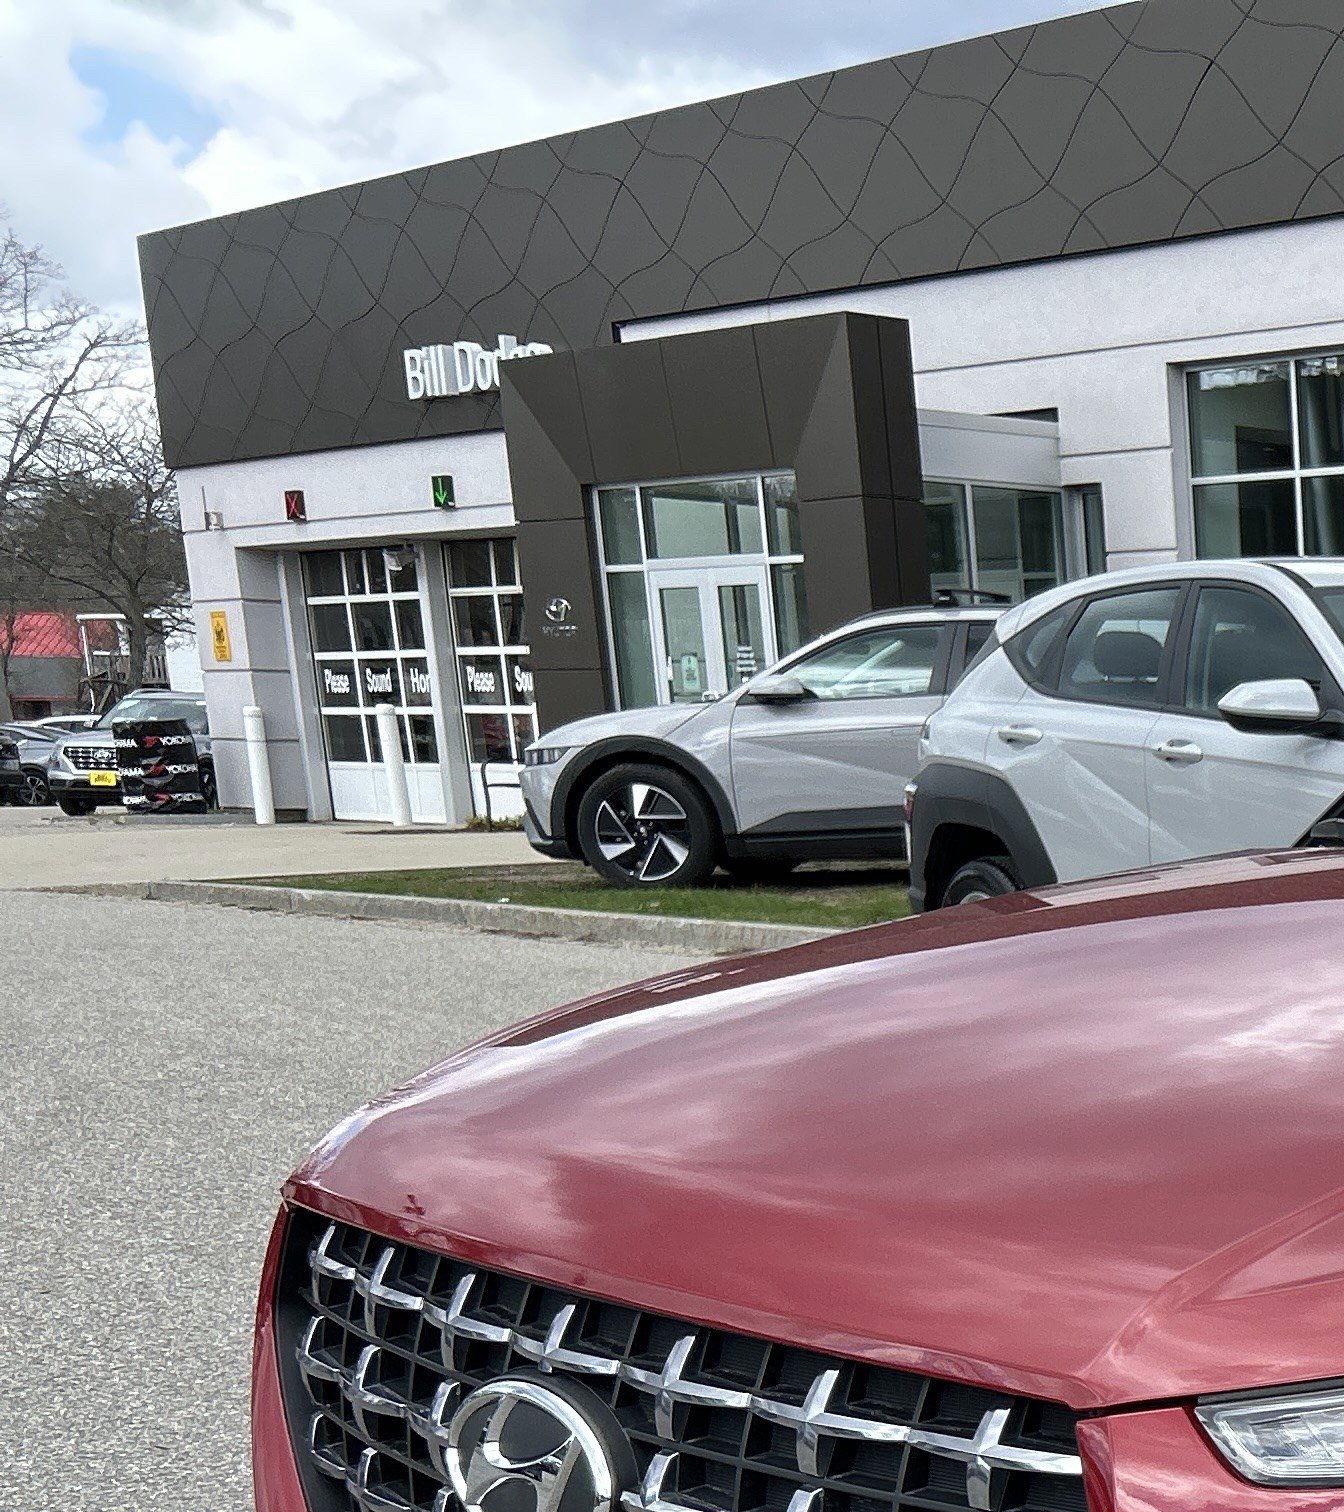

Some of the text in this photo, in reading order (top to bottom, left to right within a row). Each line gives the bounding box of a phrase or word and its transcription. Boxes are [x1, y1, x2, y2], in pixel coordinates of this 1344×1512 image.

[404, 334, 554, 400] Bill Dod
[323, 667, 432, 694] Please Sound Hor
[466, 665, 534, 693] Please Sou
